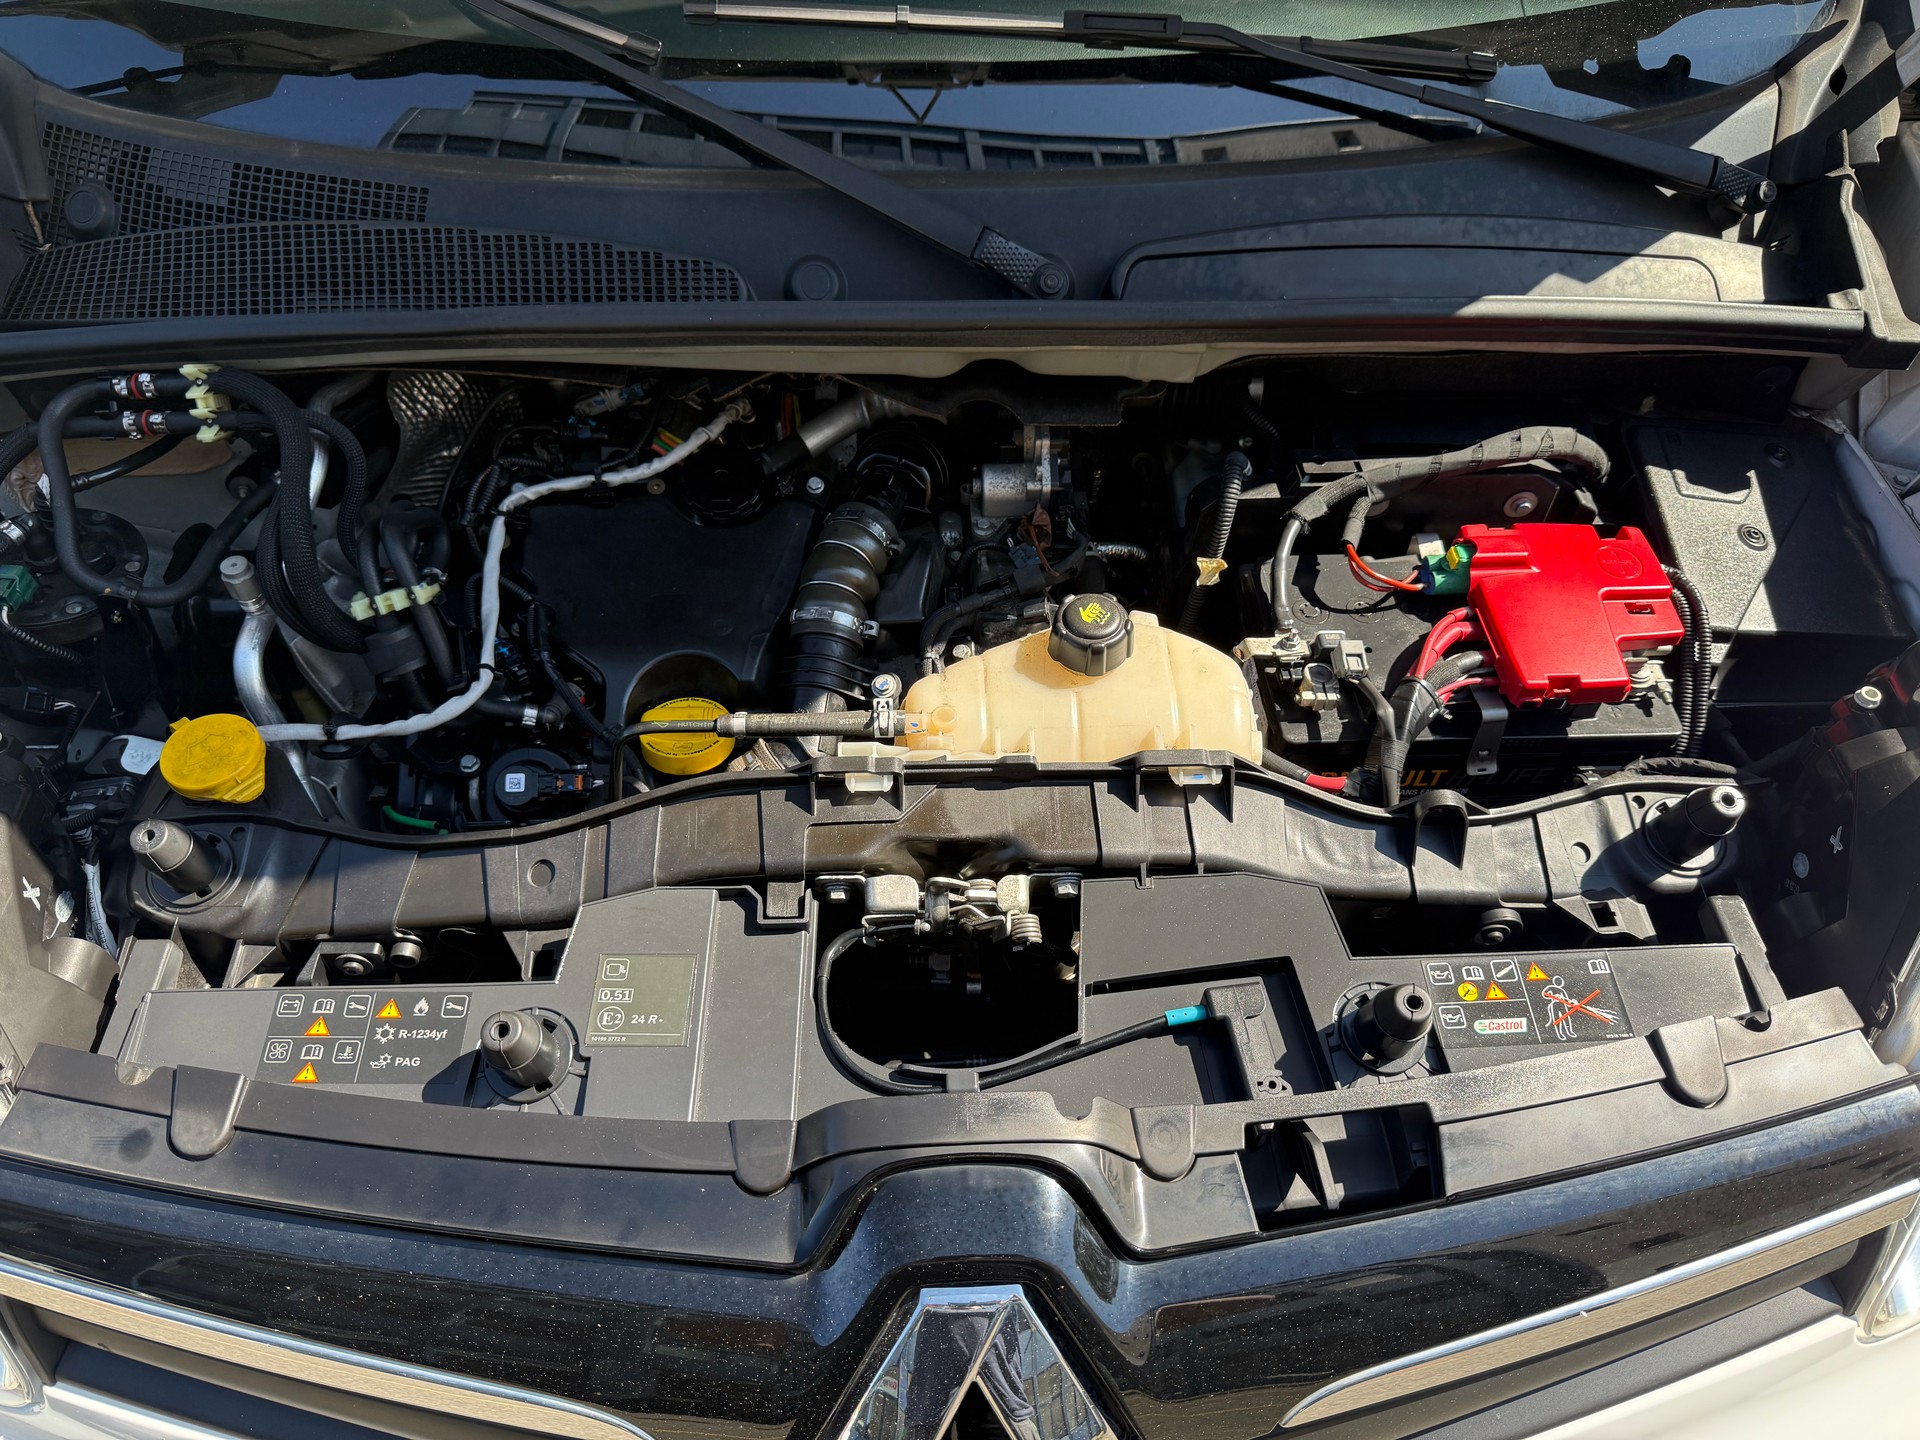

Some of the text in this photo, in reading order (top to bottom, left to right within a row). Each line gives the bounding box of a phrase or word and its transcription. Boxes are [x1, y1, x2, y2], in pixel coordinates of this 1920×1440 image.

[601, 990, 631, 1002] 0,51
[631, 1014, 645, 1024] 24
[1488, 1019, 1524, 1031] Castrol
[398, 1029, 449, 1040] R-1234yf
[394, 1057, 421, 1067] PAG
